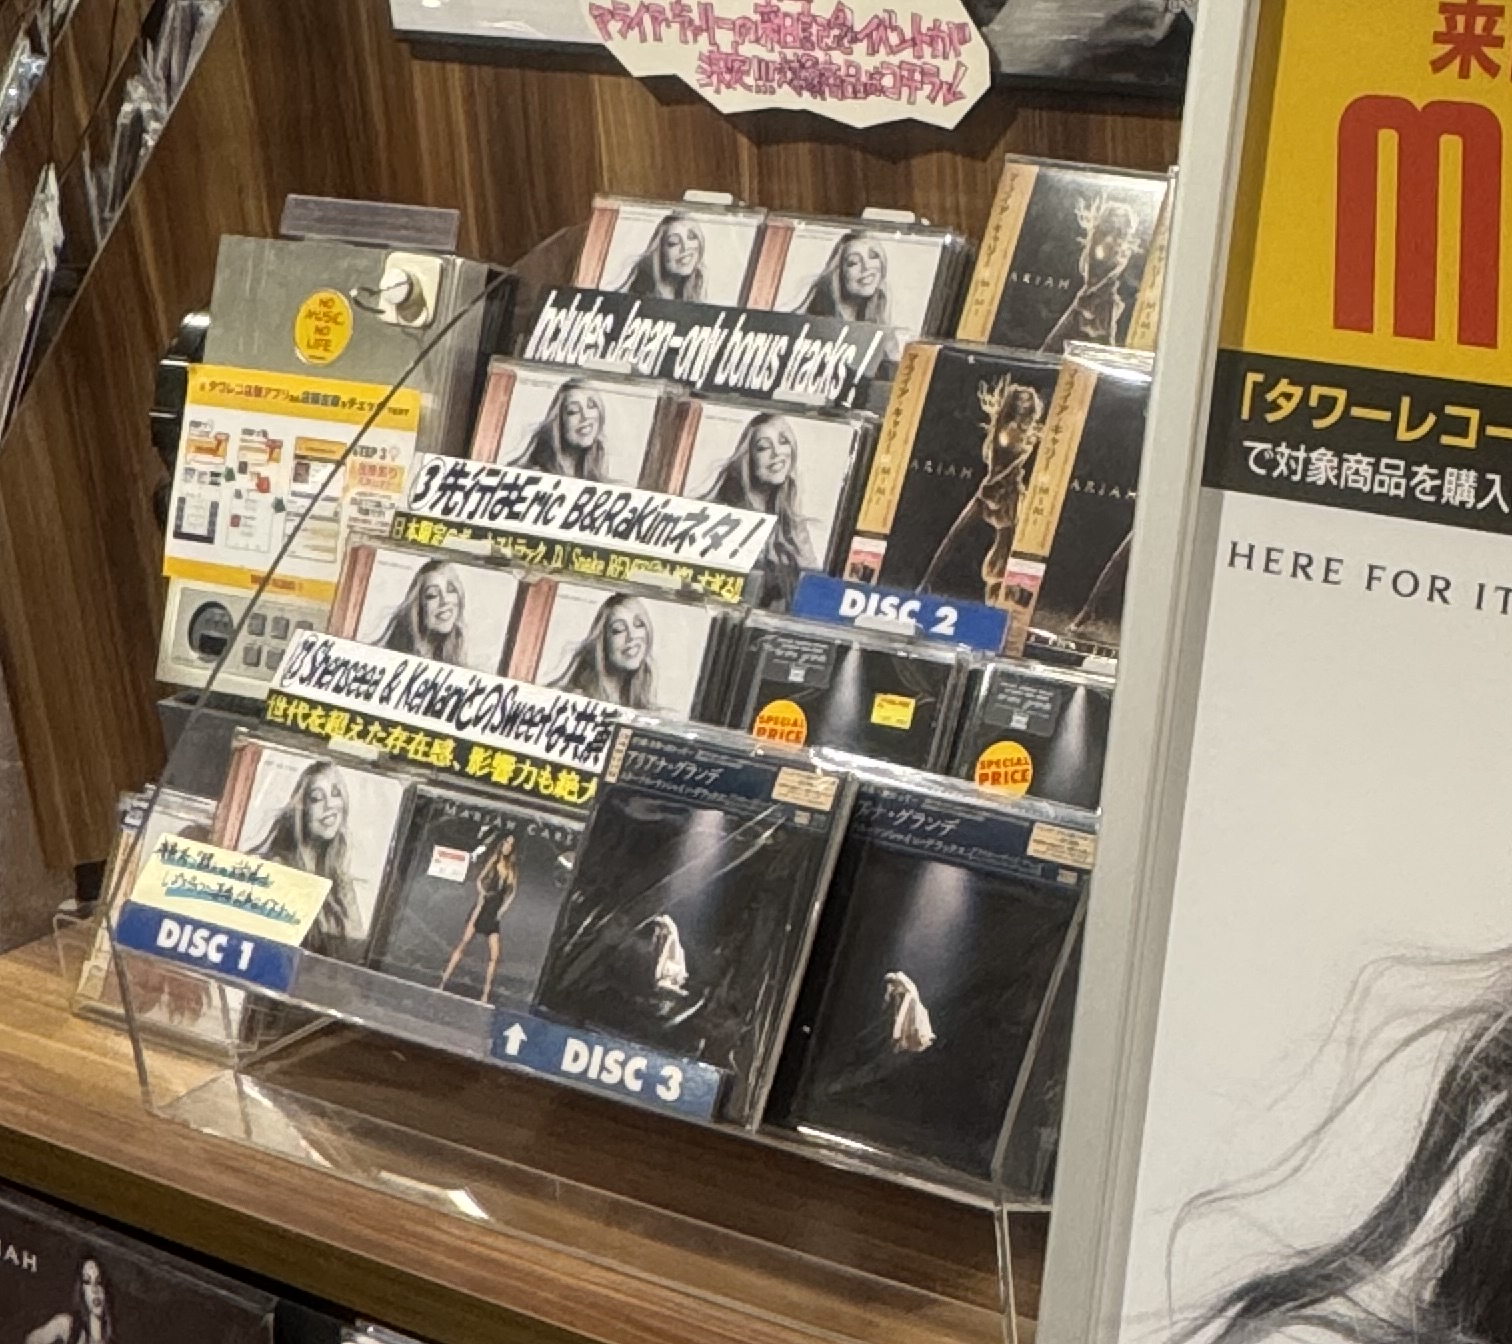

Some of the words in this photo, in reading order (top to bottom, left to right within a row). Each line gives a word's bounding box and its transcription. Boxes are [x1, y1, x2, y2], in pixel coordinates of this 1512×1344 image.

[523, 289, 614, 364] Includes
[715, 311, 790, 393] bonus
[779, 322, 858, 401] tracks
[1227, 540, 1345, 585] HERE
[1364, 563, 1453, 606] FOR
[838, 587, 919, 628] DISC
[930, 605, 959, 637] 2
[978, 768, 1030, 786] PRICE
[980, 756, 1030, 770] SPECIAL
[156, 918, 229, 964] DISC
[236, 941, 256, 972] 1
[560, 1037, 646, 1092] DISC
[656, 1066, 685, 1102] 3
